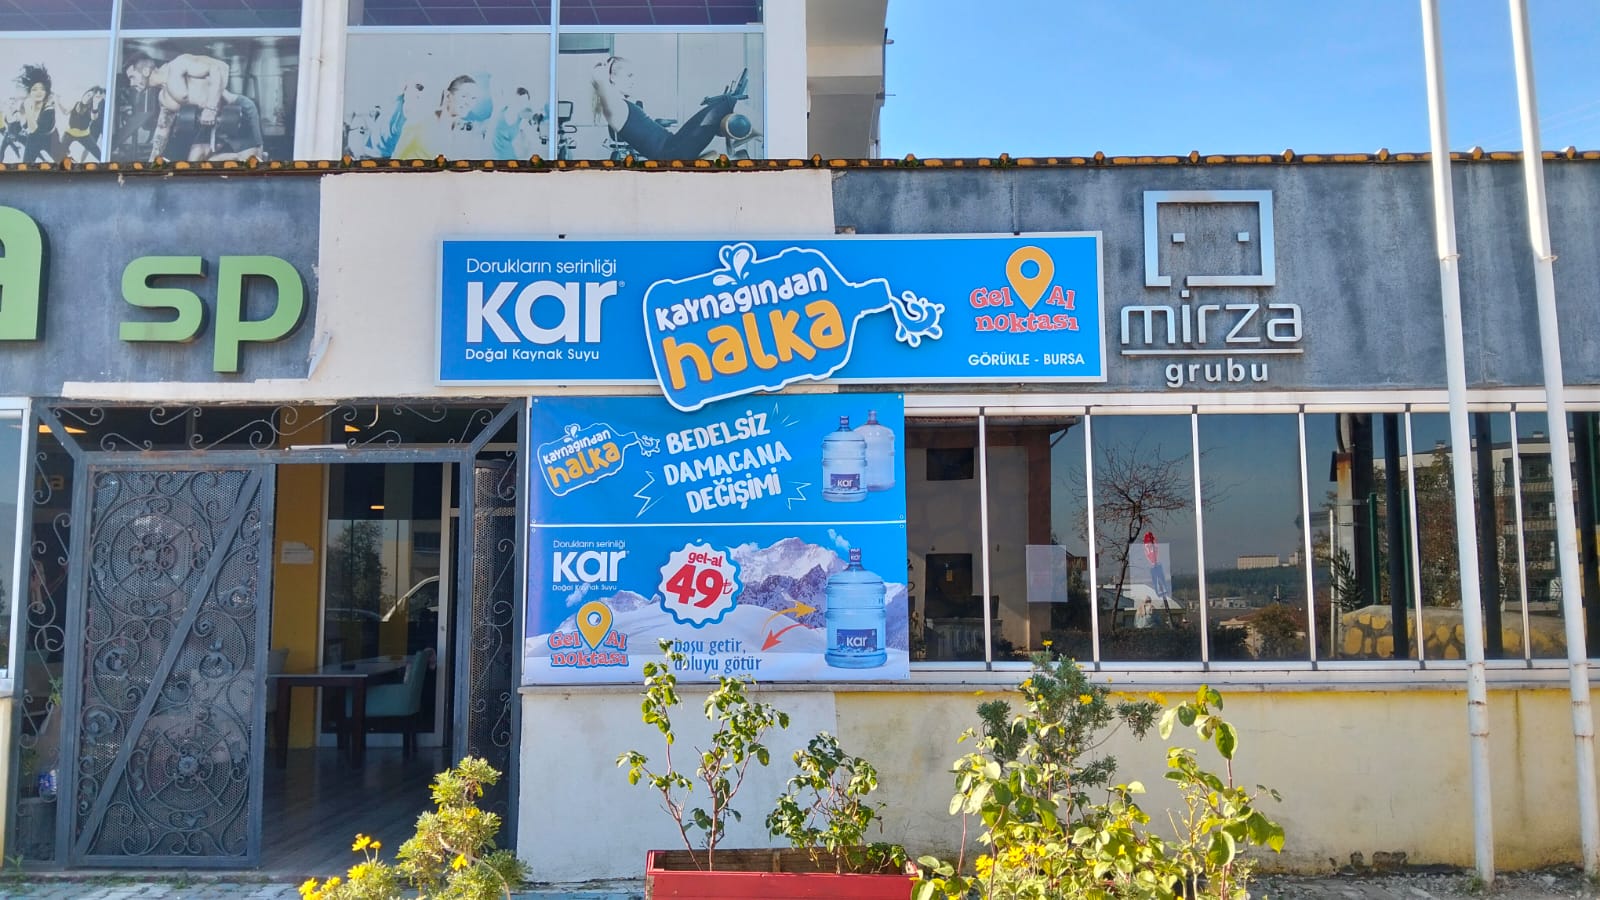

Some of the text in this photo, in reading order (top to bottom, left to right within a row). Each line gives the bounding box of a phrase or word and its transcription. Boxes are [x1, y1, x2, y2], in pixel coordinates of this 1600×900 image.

[466, 258, 617, 277] Dorukların serinliği
[969, 285, 1076, 310] Gel Al
[975, 312, 1079, 333] noktası
[1120, 290, 1303, 344] mirza
[466, 348, 600, 362] Doğal Kaynak Suyu
[662, 299, 846, 390] halka
[968, 352, 1030, 366] GÖRÜKLE
[1043, 353, 1086, 365] BURSA
[1165, 358, 1268, 388] grubu
[665, 409, 771, 455] BEDELSİZ
[547, 441, 621, 488] halka
[663, 440, 793, 486] DAMACANA
[685, 466, 781, 514] DEĞİŞİMİ
[687, 552, 723, 568] gel-al
[549, 630, 628, 649] Gel Al
[709, 638, 746, 656] getir,
[551, 651, 629, 666] noktası
[724, 656, 762, 674] götür
